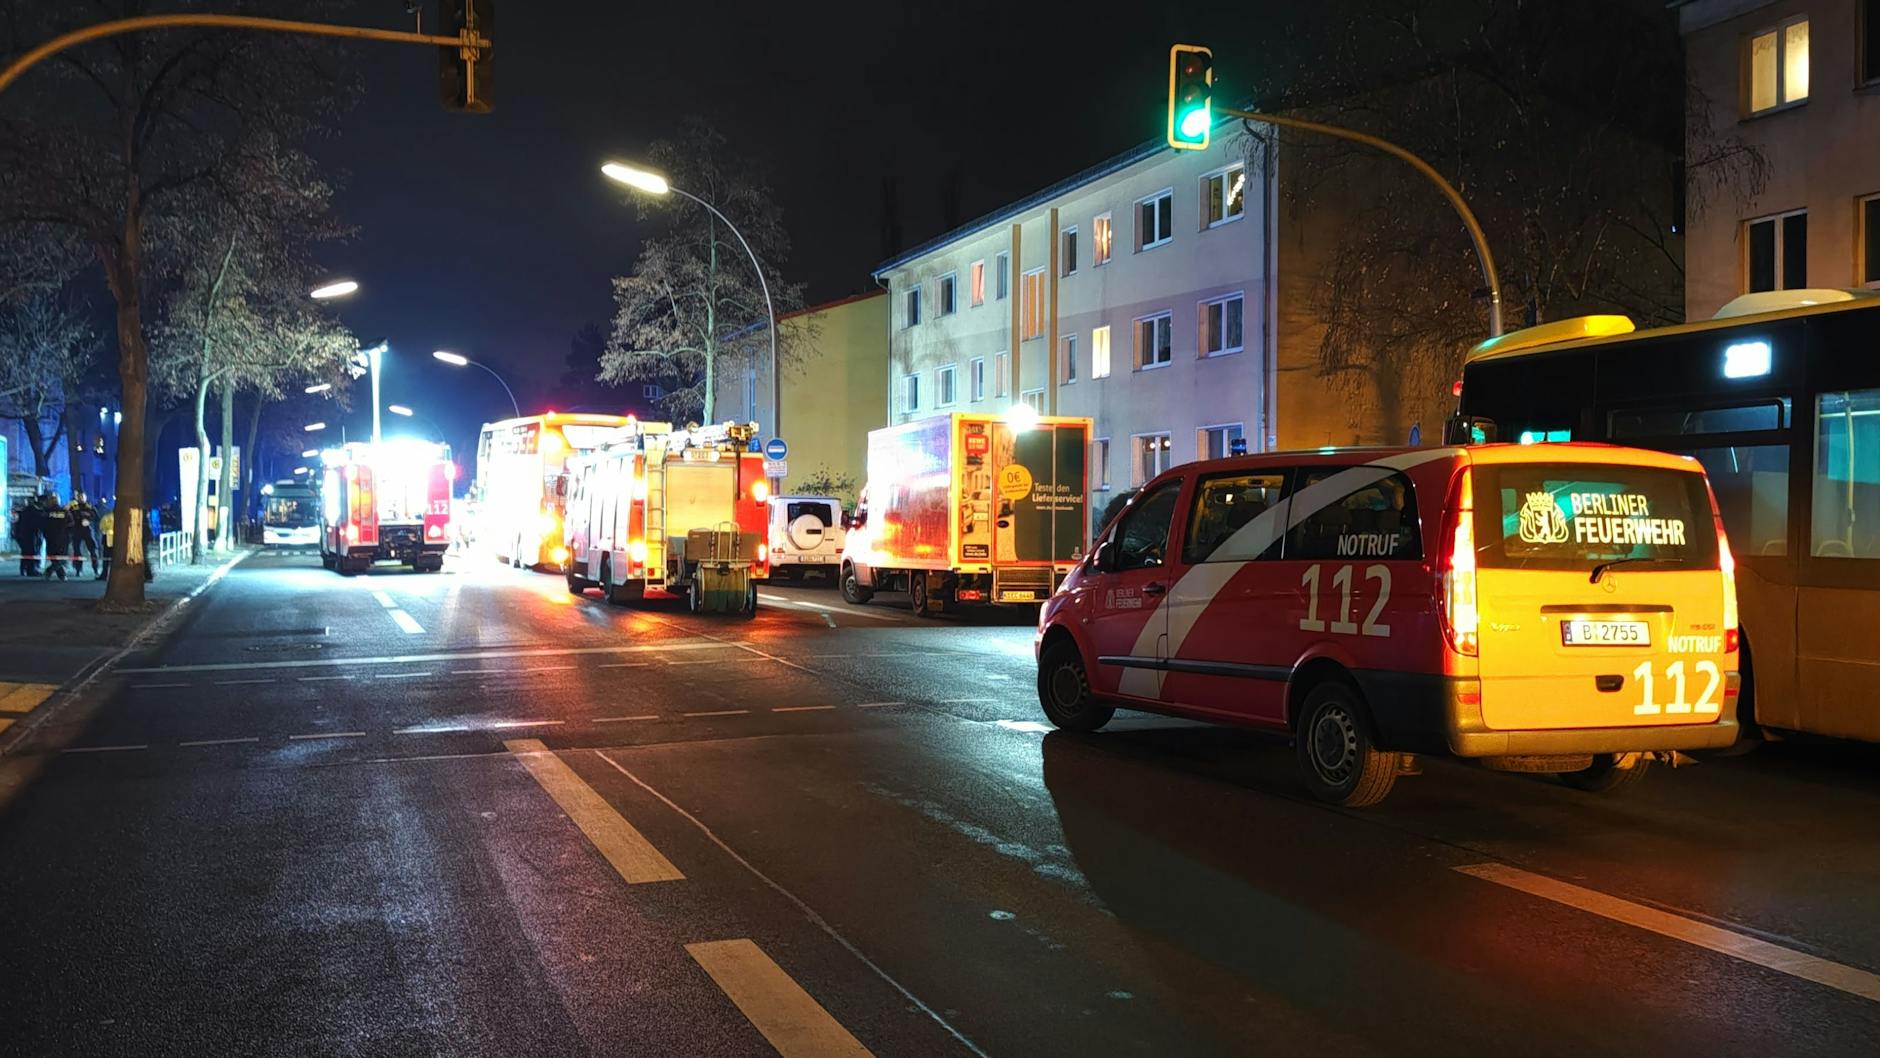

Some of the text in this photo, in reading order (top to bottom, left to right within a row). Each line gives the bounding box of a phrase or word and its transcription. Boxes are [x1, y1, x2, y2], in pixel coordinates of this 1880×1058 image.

[1056, 484, 1070, 493] den
[426, 503, 449, 515] 112
[1571, 492, 1649, 516] BERLINER
[1574, 516, 1686, 545] FEUERWEHR
[1337, 533, 1400, 556] NOTRUF
[1299, 563, 1392, 638] 112
[1583, 624, 1638, 641] B 2755
[1667, 635, 1722, 654] NOTRUF
[1632, 659, 1721, 716] 112
